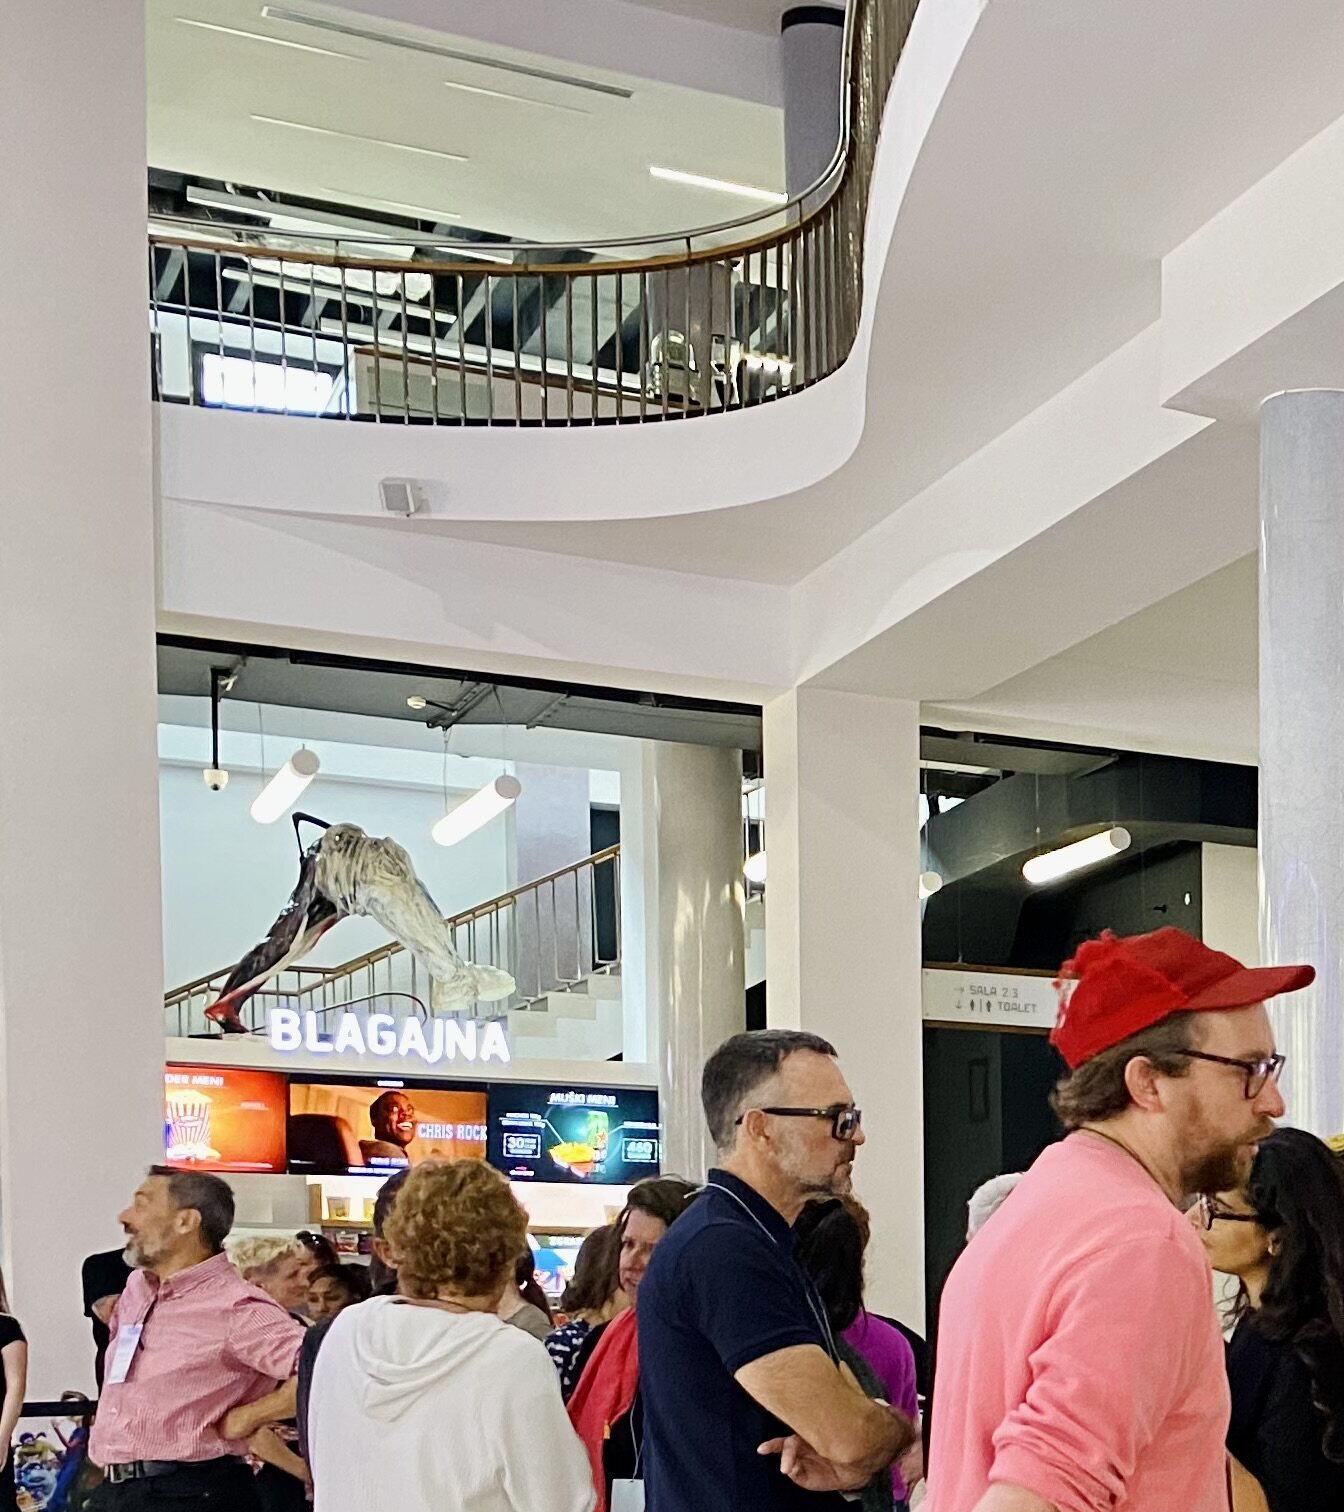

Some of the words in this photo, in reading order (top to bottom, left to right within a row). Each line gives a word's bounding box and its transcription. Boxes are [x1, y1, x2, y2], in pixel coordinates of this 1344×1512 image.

[969, 985, 997, 996] SALA
[1002, 987, 1008, 998] 2
[1013, 988, 1019, 998] 3
[998, 1001, 1037, 1013] TOALET
[269, 1008, 511, 1064] BLAGAJNA
[418, 1123, 453, 1139] CHRIS
[457, 1125, 488, 1141] ROCK
[507, 1137, 525, 1149] 30
